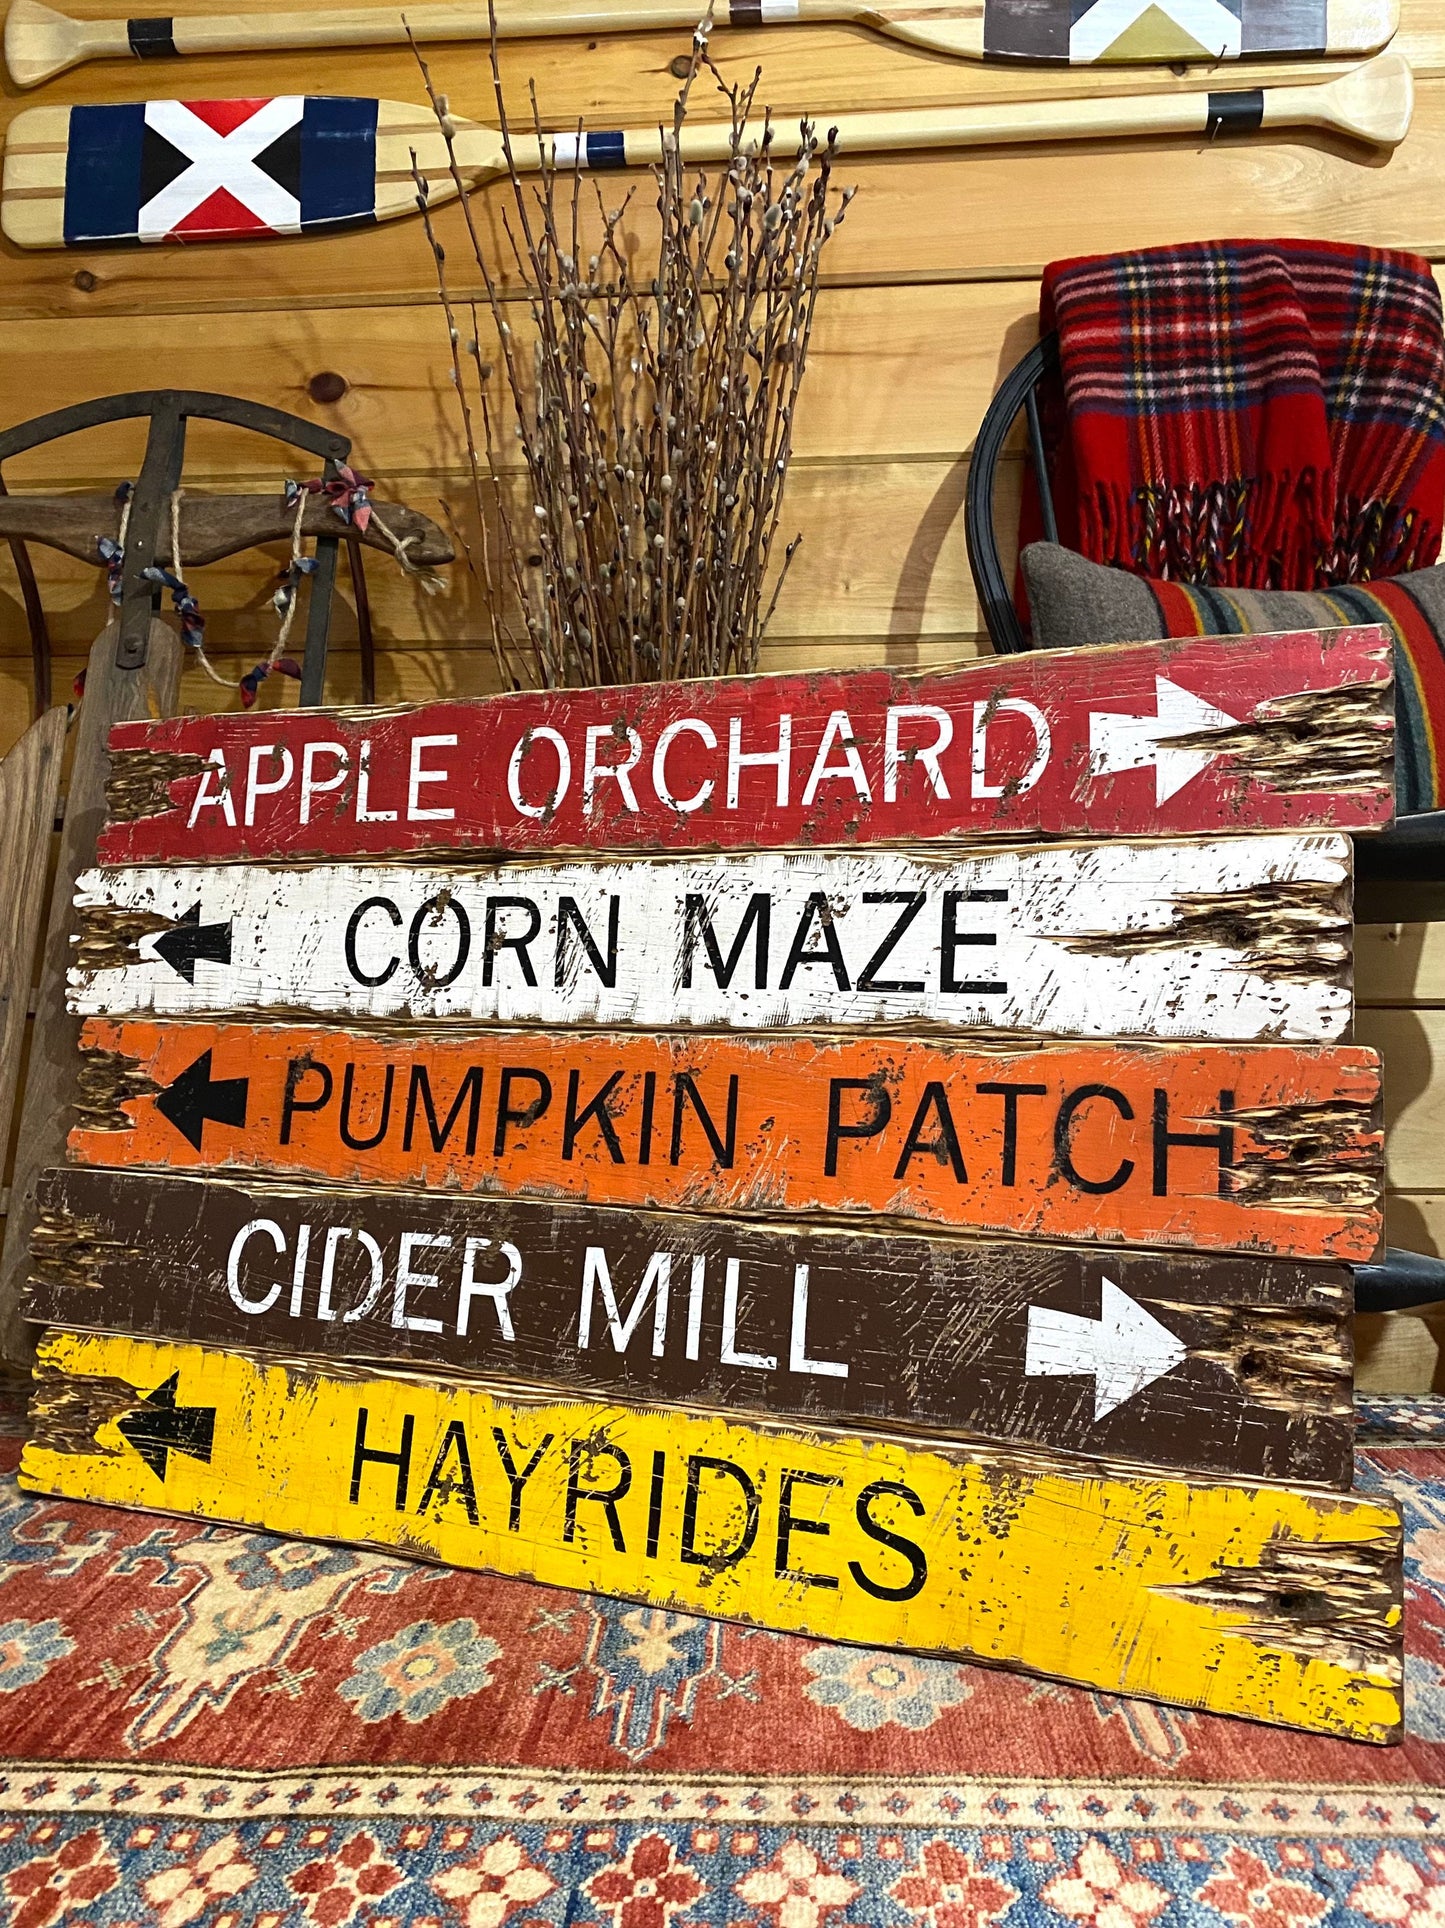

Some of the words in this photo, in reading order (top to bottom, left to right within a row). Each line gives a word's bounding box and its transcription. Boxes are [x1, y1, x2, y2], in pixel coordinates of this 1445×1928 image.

[186, 733, 459, 829] APPLE
[506, 698, 1053, 821] ORCHARD
[344, 895, 620, 989] CORN
[681, 889, 1009, 994] MAZE
[279, 1057, 739, 1170] PUMPKIN
[824, 1077, 1235, 1197] PATCH
[227, 1218, 524, 1341] CIDER
[577, 1246, 849, 1378] MILL
[349, 1407, 928, 1602] HAYRIDES
